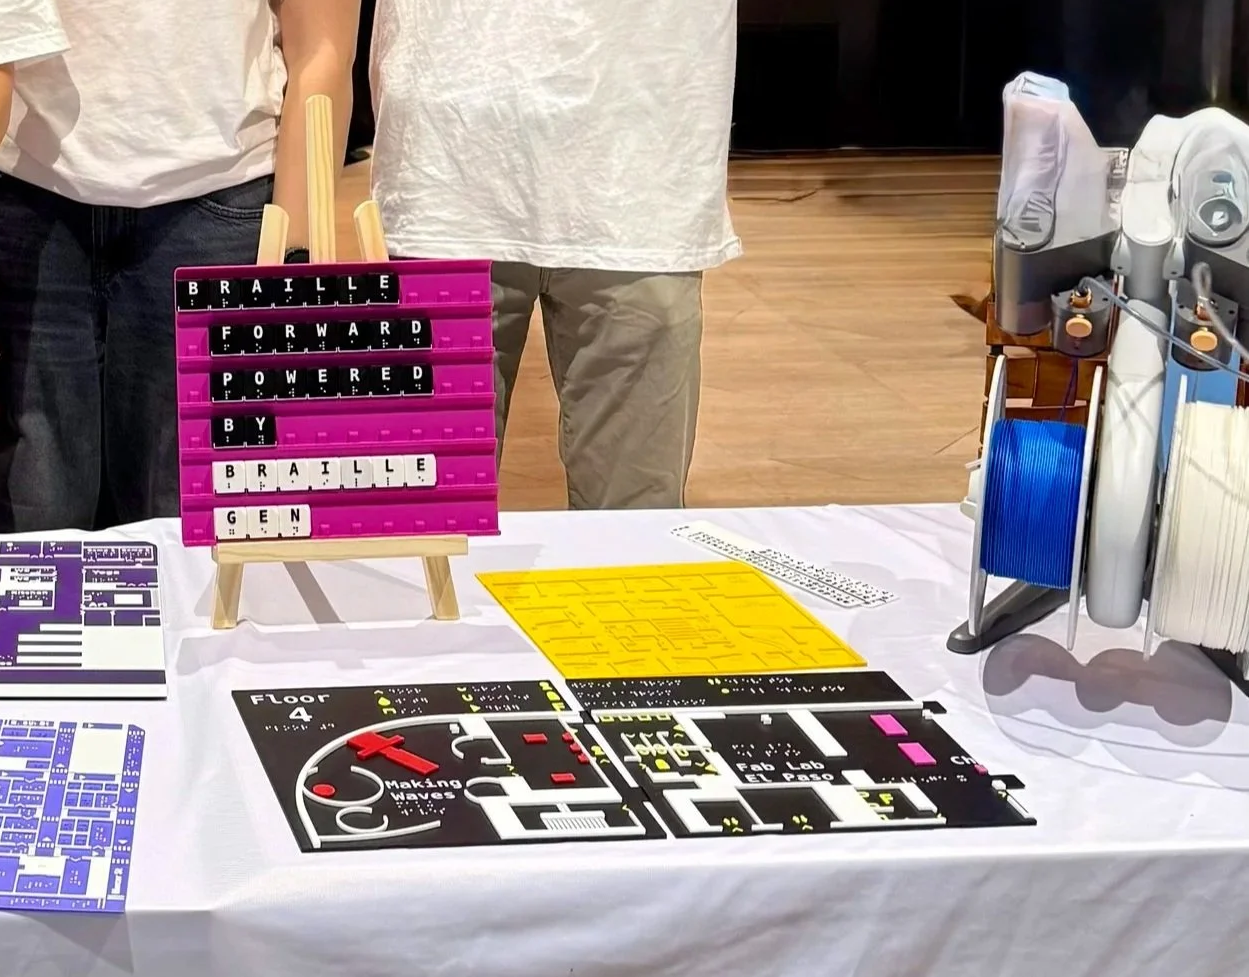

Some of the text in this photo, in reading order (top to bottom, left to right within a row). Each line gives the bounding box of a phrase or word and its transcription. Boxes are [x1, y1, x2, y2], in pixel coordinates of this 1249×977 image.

[188, 275, 389, 296] BRAILLE
[221, 320, 422, 340] FORWARD
[222, 366, 423, 386] POWERED
[224, 416, 266, 432] BY
[225, 458, 425, 479] BRAILLE
[227, 509, 300, 525] GEN
[250, 692, 331, 705] Floor
[288, 707, 313, 722] 4
[736, 759, 825, 772] Fab Lab
[385, 777, 463, 792] Making
[749, 770, 834, 784] El Paso
[390, 789, 456, 802] Waves
